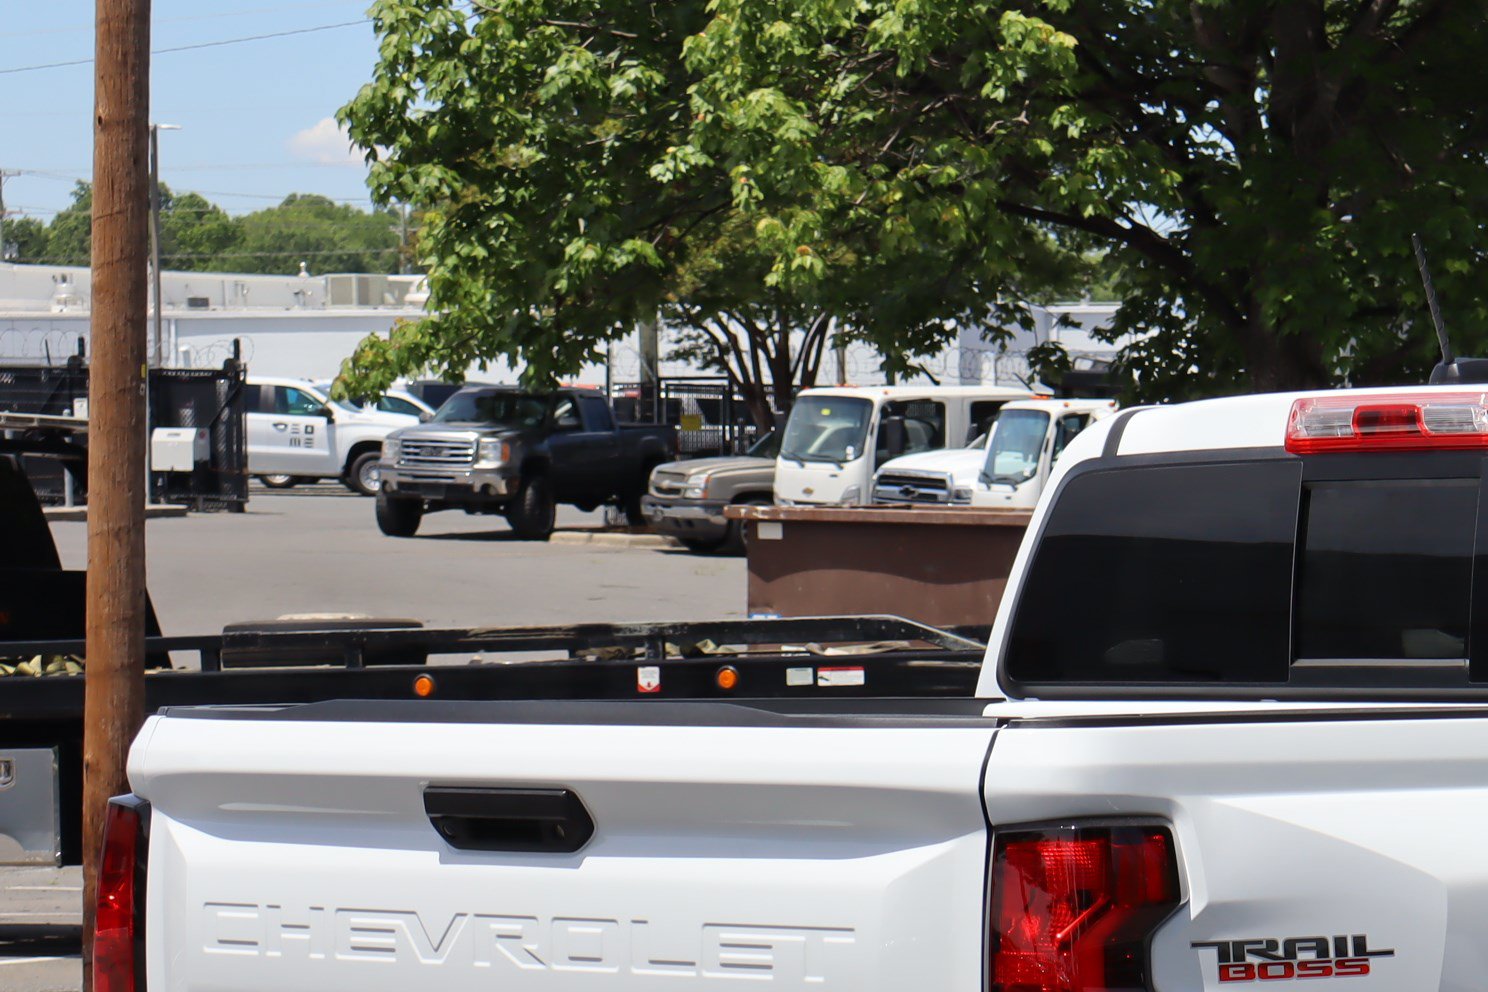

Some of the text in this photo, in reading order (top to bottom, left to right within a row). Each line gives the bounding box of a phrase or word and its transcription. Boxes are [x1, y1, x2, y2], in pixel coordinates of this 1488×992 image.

[202, 900, 855, 983] CHEVROLET
[1190, 934, 1395, 963] TRAIL
[1218, 958, 1370, 983] BOSS
